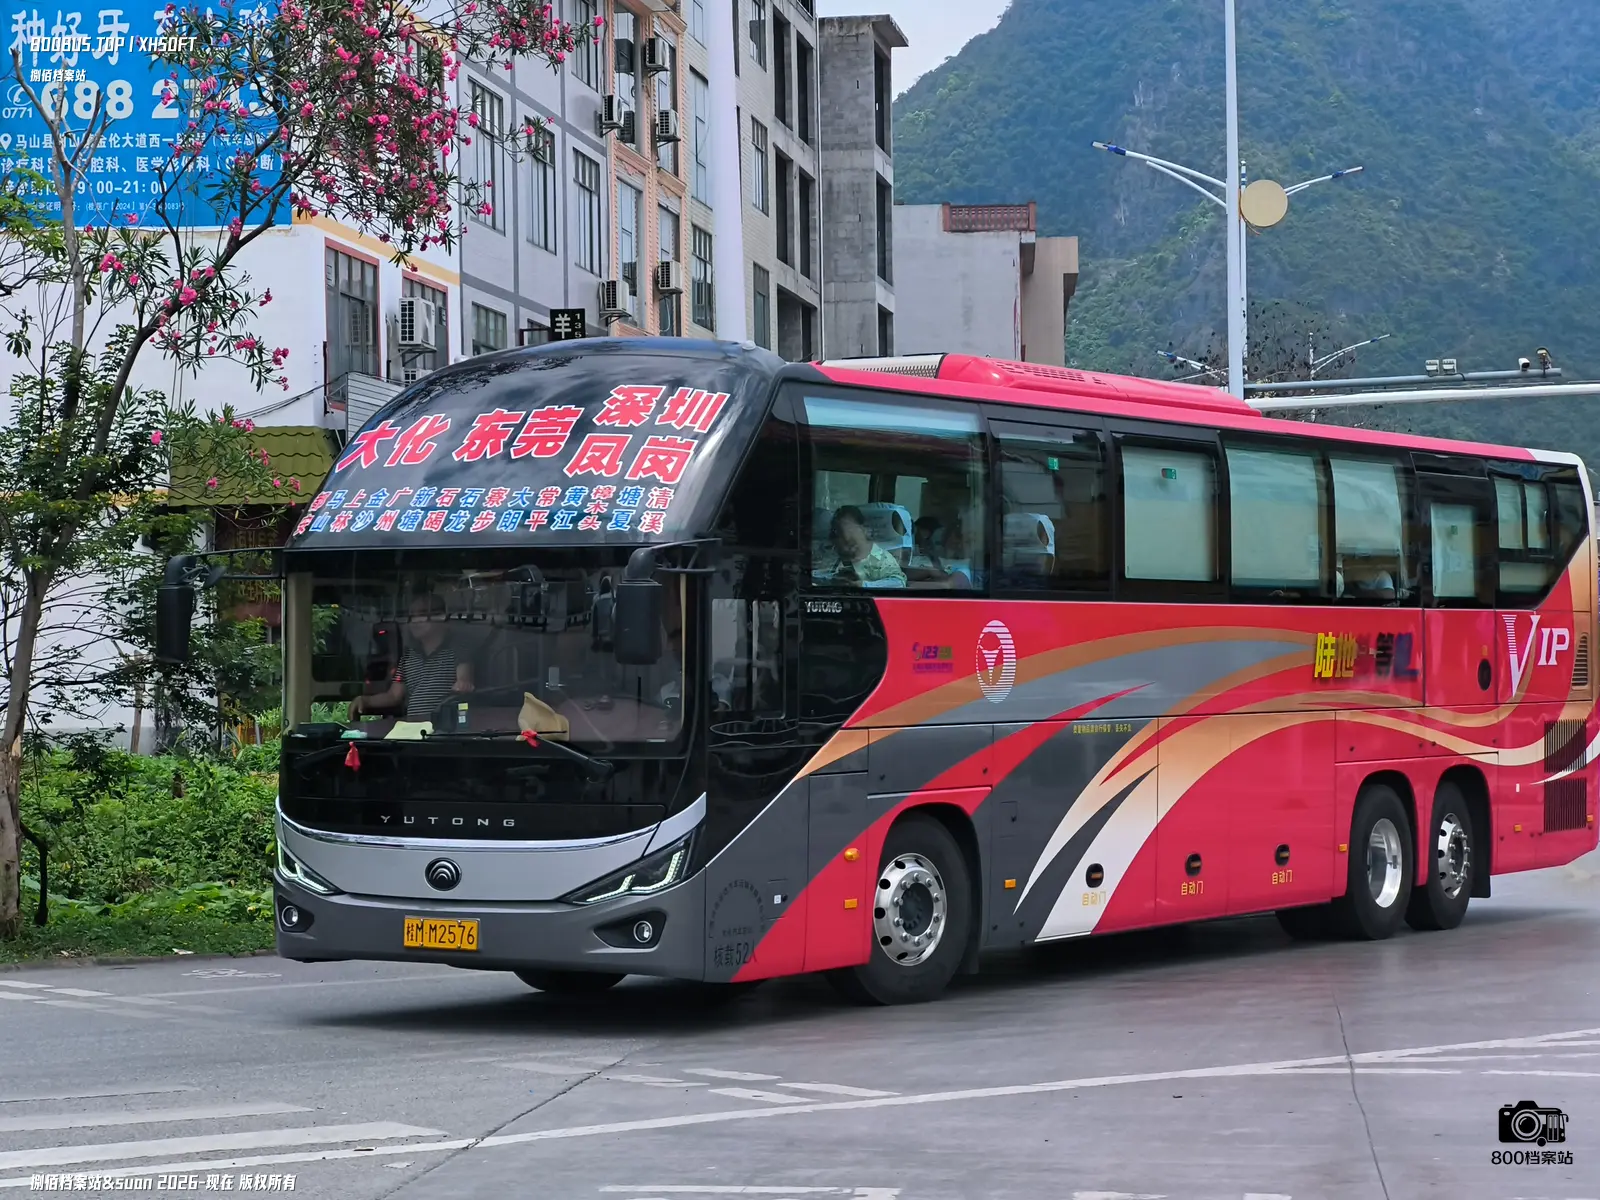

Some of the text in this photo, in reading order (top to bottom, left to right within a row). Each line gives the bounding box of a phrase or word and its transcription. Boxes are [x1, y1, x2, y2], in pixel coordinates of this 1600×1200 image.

[8, 9, 130, 67] 种好牙
[2, 107, 32, 118] 0771
[41, 79, 134, 119] 688
[554, 313, 572, 339] 羊
[593, 384, 730, 434] 深圳
[335, 404, 582, 474] 大化 东莞
[563, 433, 698, 484] 凤岗
[309, 489, 348, 532] 马山
[329, 489, 367, 532] 上林
[350, 488, 389, 532] 金沙
[373, 487, 413, 531] 广州
[398, 486, 437, 532] 新塘
[421, 488, 461, 532] 石碣
[443, 488, 485, 532] 石龙
[497, 486, 532, 532] 大朗
[524, 485, 561, 532] 常平
[550, 485, 589, 530] 黄江
[578, 485, 616, 531] 樟木头
[638, 486, 674, 534] 清溪
[805, 601, 843, 613] YUTONG
[1502, 614, 1570, 697] VIP
[380, 814, 515, 828] YUTONG
[1082, 892, 1107, 906] 自动门
[1181, 881, 1204, 895] 自动门
[1272, 870, 1293, 884] 自动门
